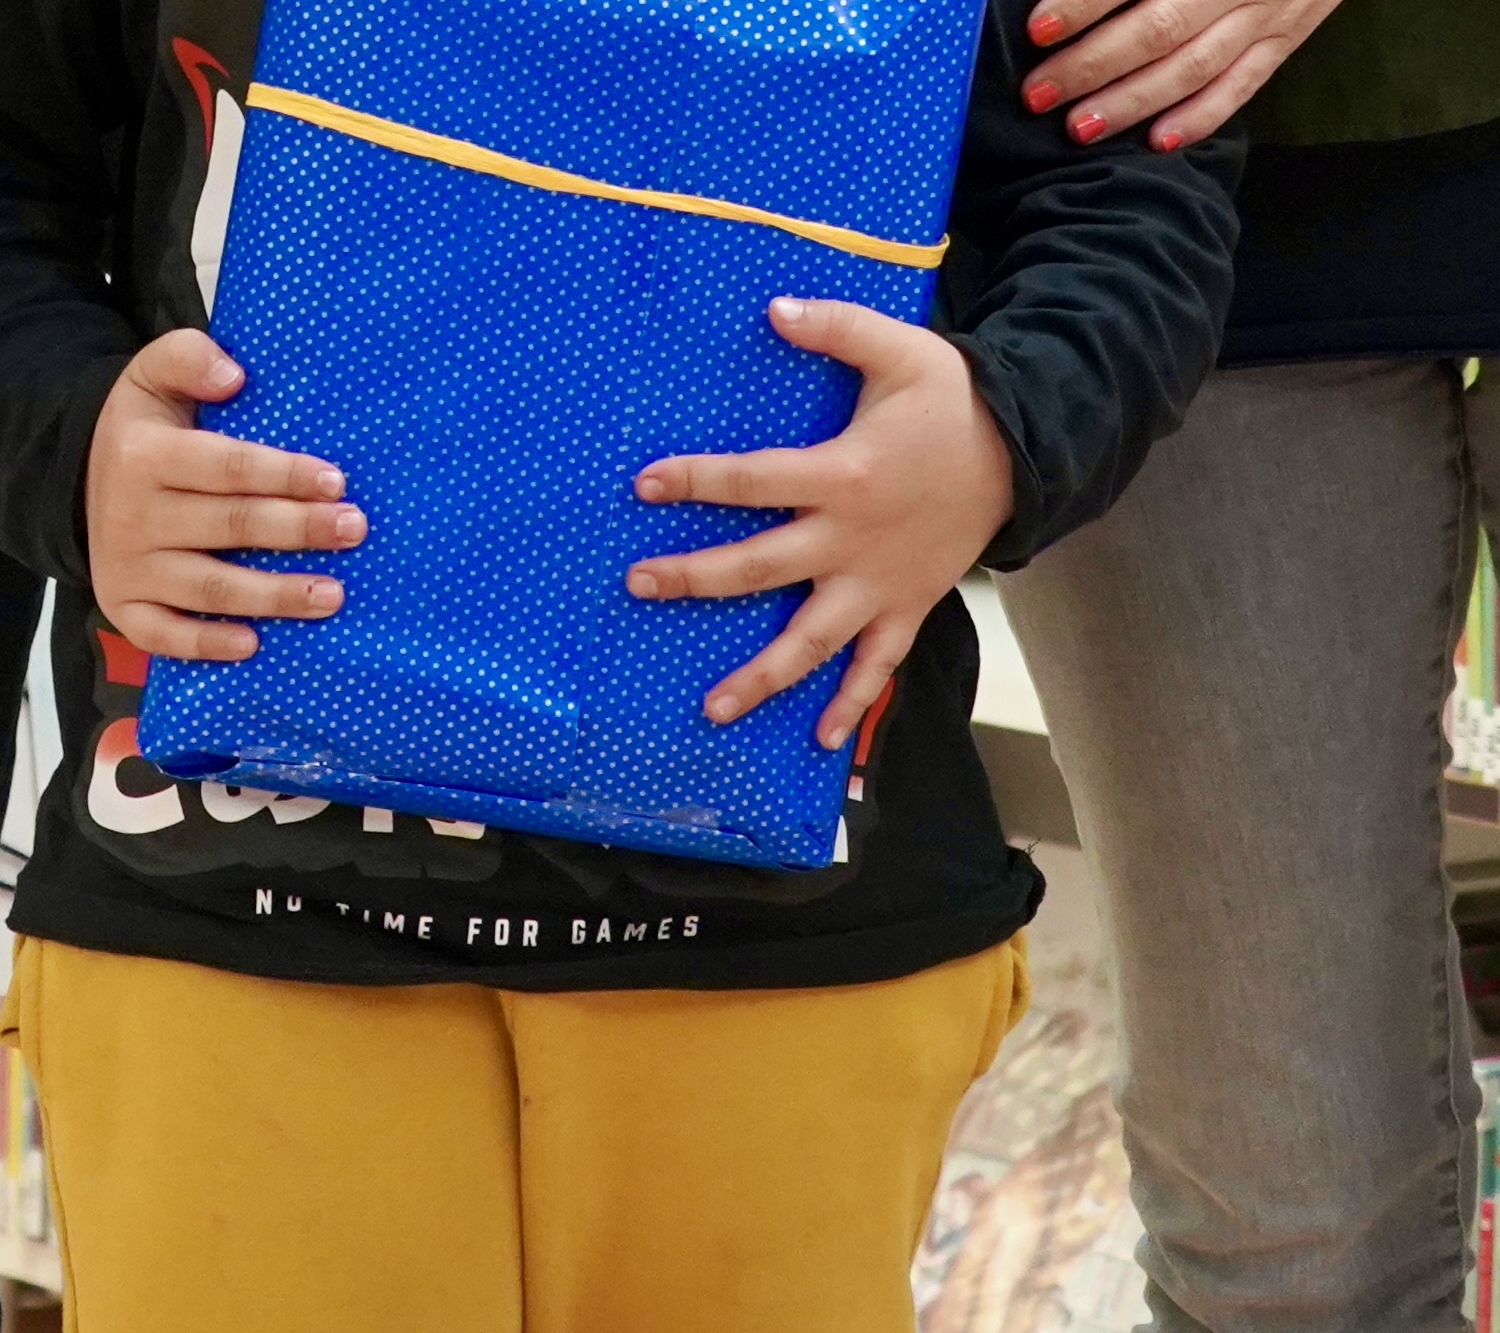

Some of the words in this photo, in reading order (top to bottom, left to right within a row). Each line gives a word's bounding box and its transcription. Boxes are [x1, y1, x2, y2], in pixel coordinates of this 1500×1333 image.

[336, 901, 434, 940] TIME
[467, 917, 539, 947] FOR
[571, 914, 701, 945] GAMES
